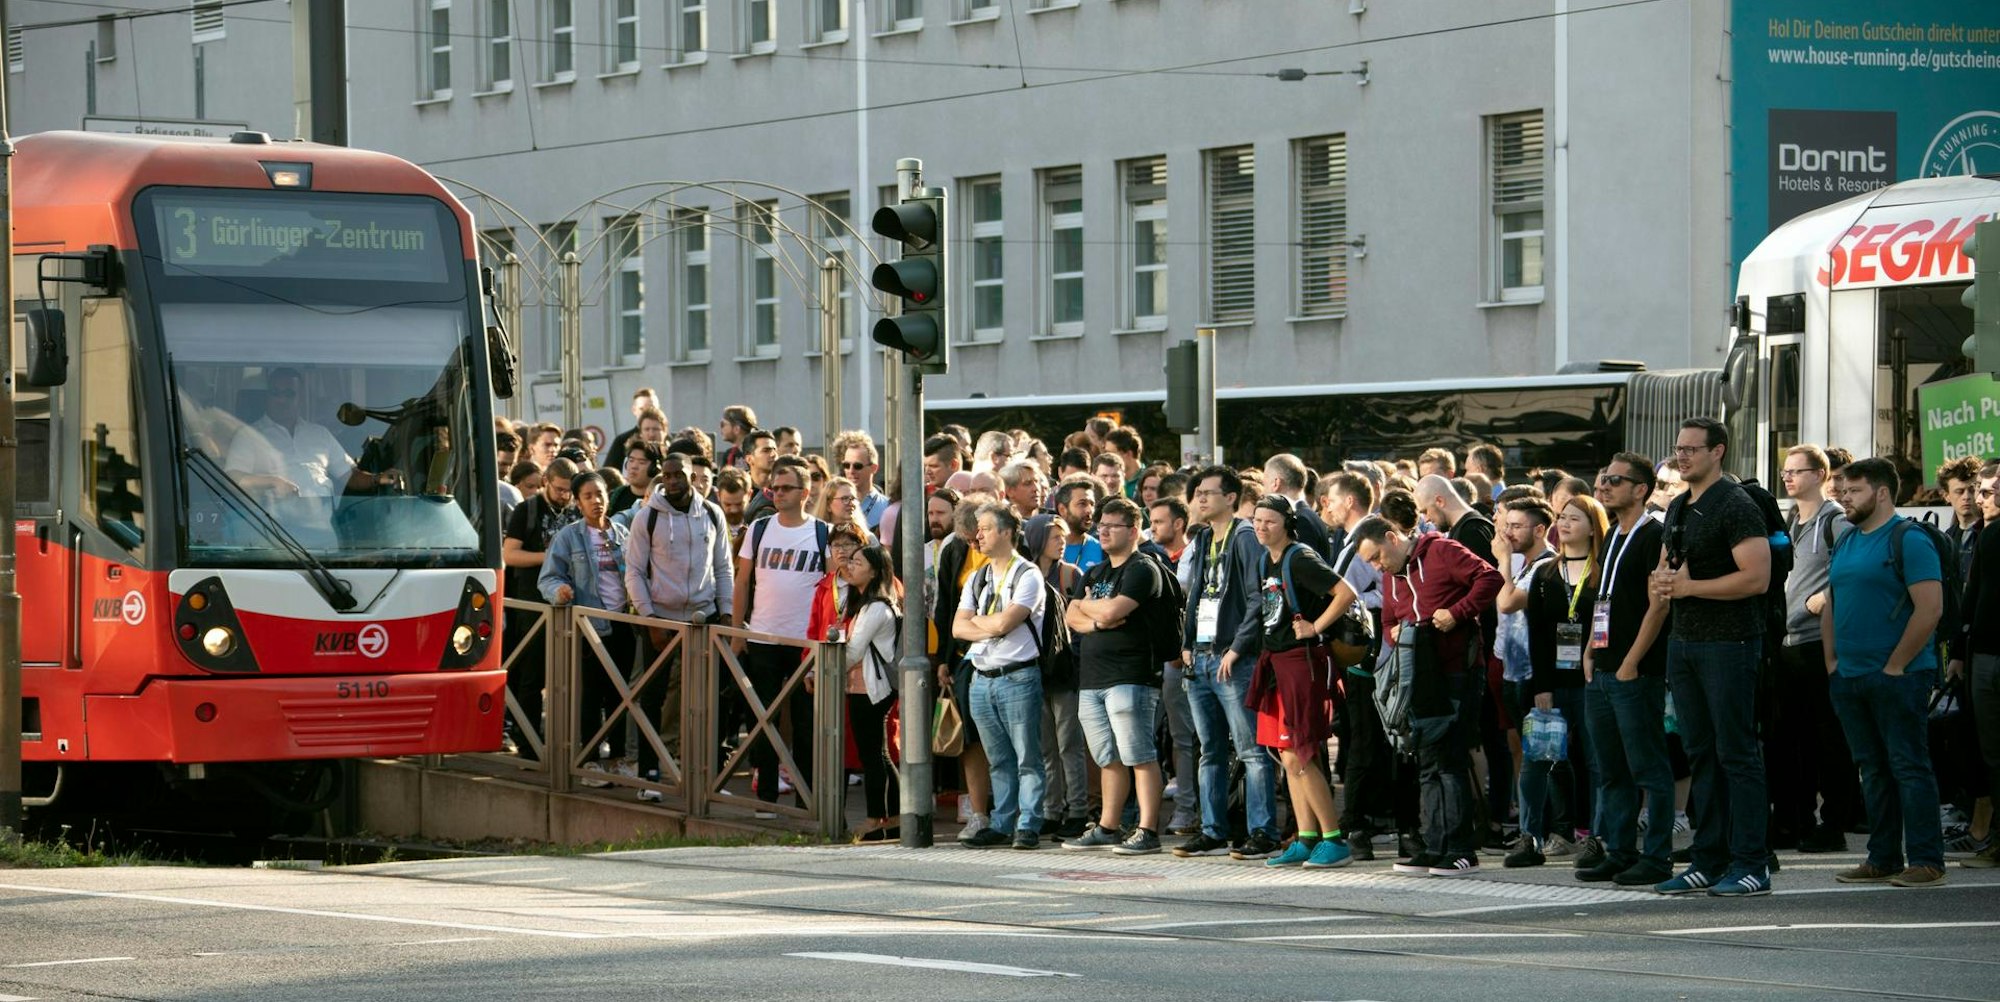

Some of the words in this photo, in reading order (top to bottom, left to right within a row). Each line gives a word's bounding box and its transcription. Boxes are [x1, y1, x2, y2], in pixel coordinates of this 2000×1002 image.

[1768, 18, 1790, 38] Hol
[1793, 19, 1812, 39] Dir
[1814, 20, 1859, 40] Deinen
[1862, 21, 1924, 42] Gutschein
[1927, 23, 1964, 43] direkt
[1938, 123, 1988, 161] RUNNING
[1778, 143, 1887, 173] Dorint
[1778, 175, 1820, 192] Hotels
[1824, 176, 1834, 192] &
[174, 206, 197, 258] 3
[211, 215, 425, 253] Görlinger-Zentrum
[1927, 399, 1976, 431] Nach
[1942, 431, 1995, 461] heißt
[92, 598, 122, 618] KVB
[314, 631, 358, 652] KVB
[337, 680, 390, 699] 5110
